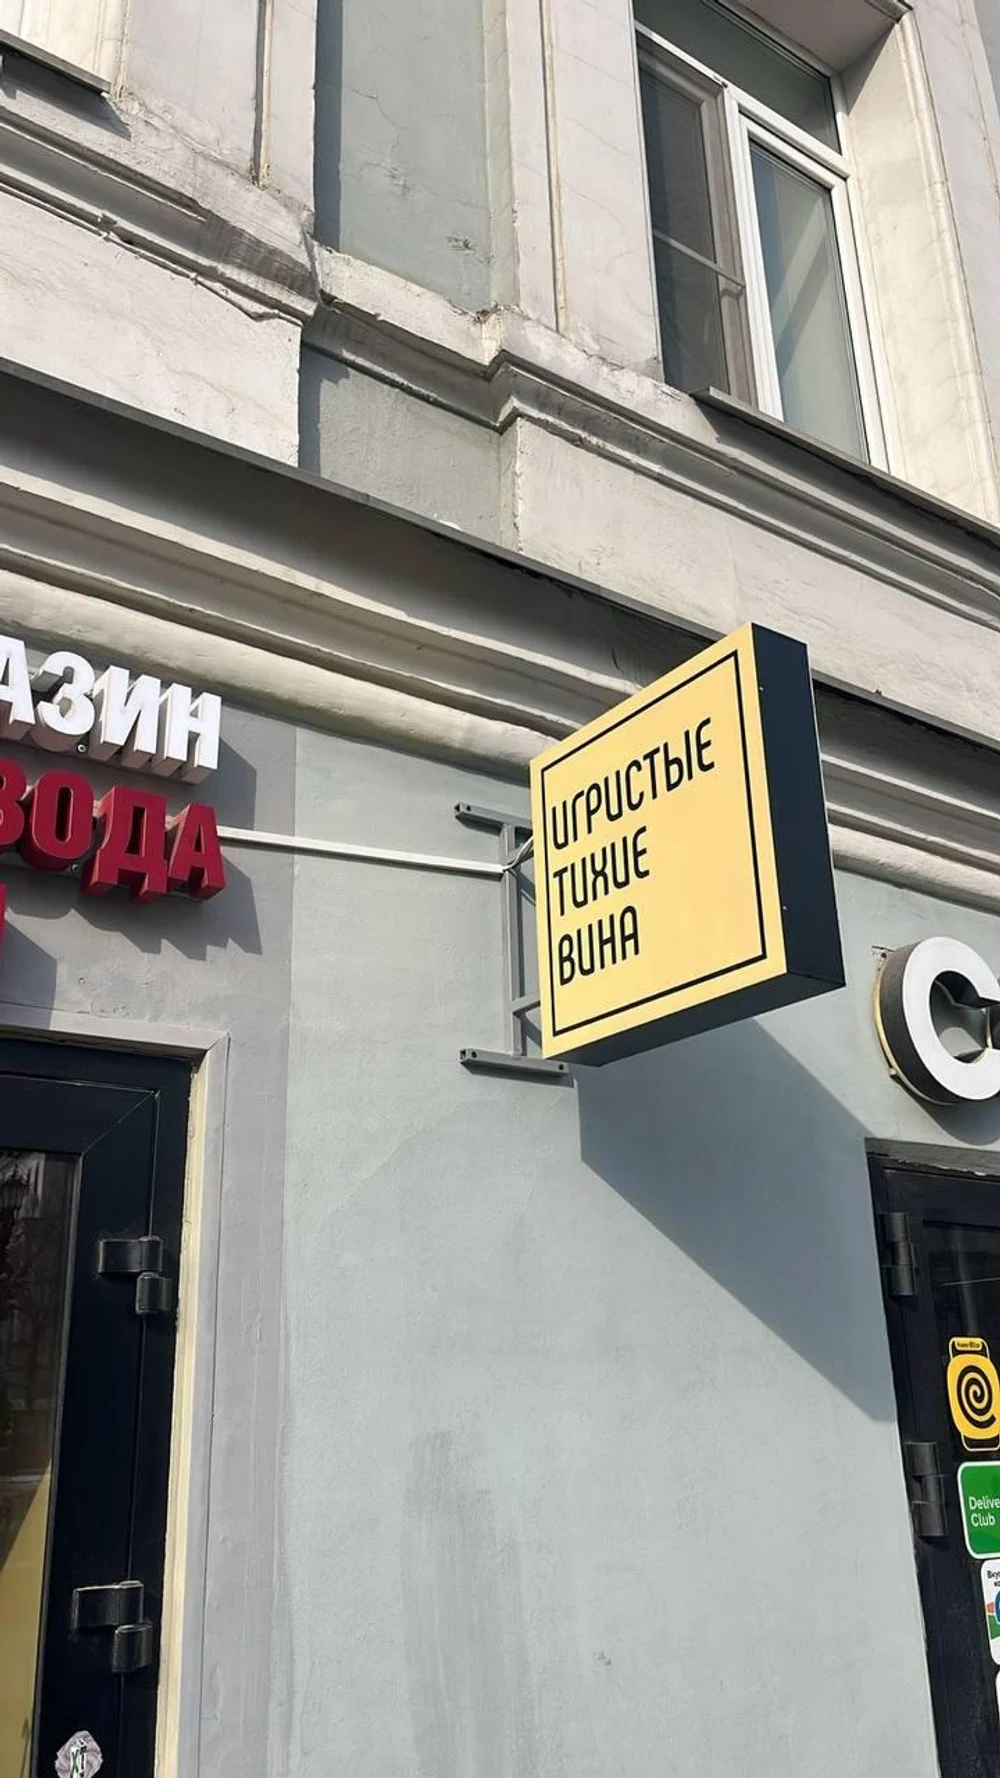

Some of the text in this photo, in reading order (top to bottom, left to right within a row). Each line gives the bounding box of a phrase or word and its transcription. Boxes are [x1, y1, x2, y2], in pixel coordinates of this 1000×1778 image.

[551, 717, 715, 850] ИГРИСТЫЕ
[553, 826, 650, 916] ТИХИЕ
[558, 905, 640, 986] ВИНА
[971, 1513, 996, 1527] Club
